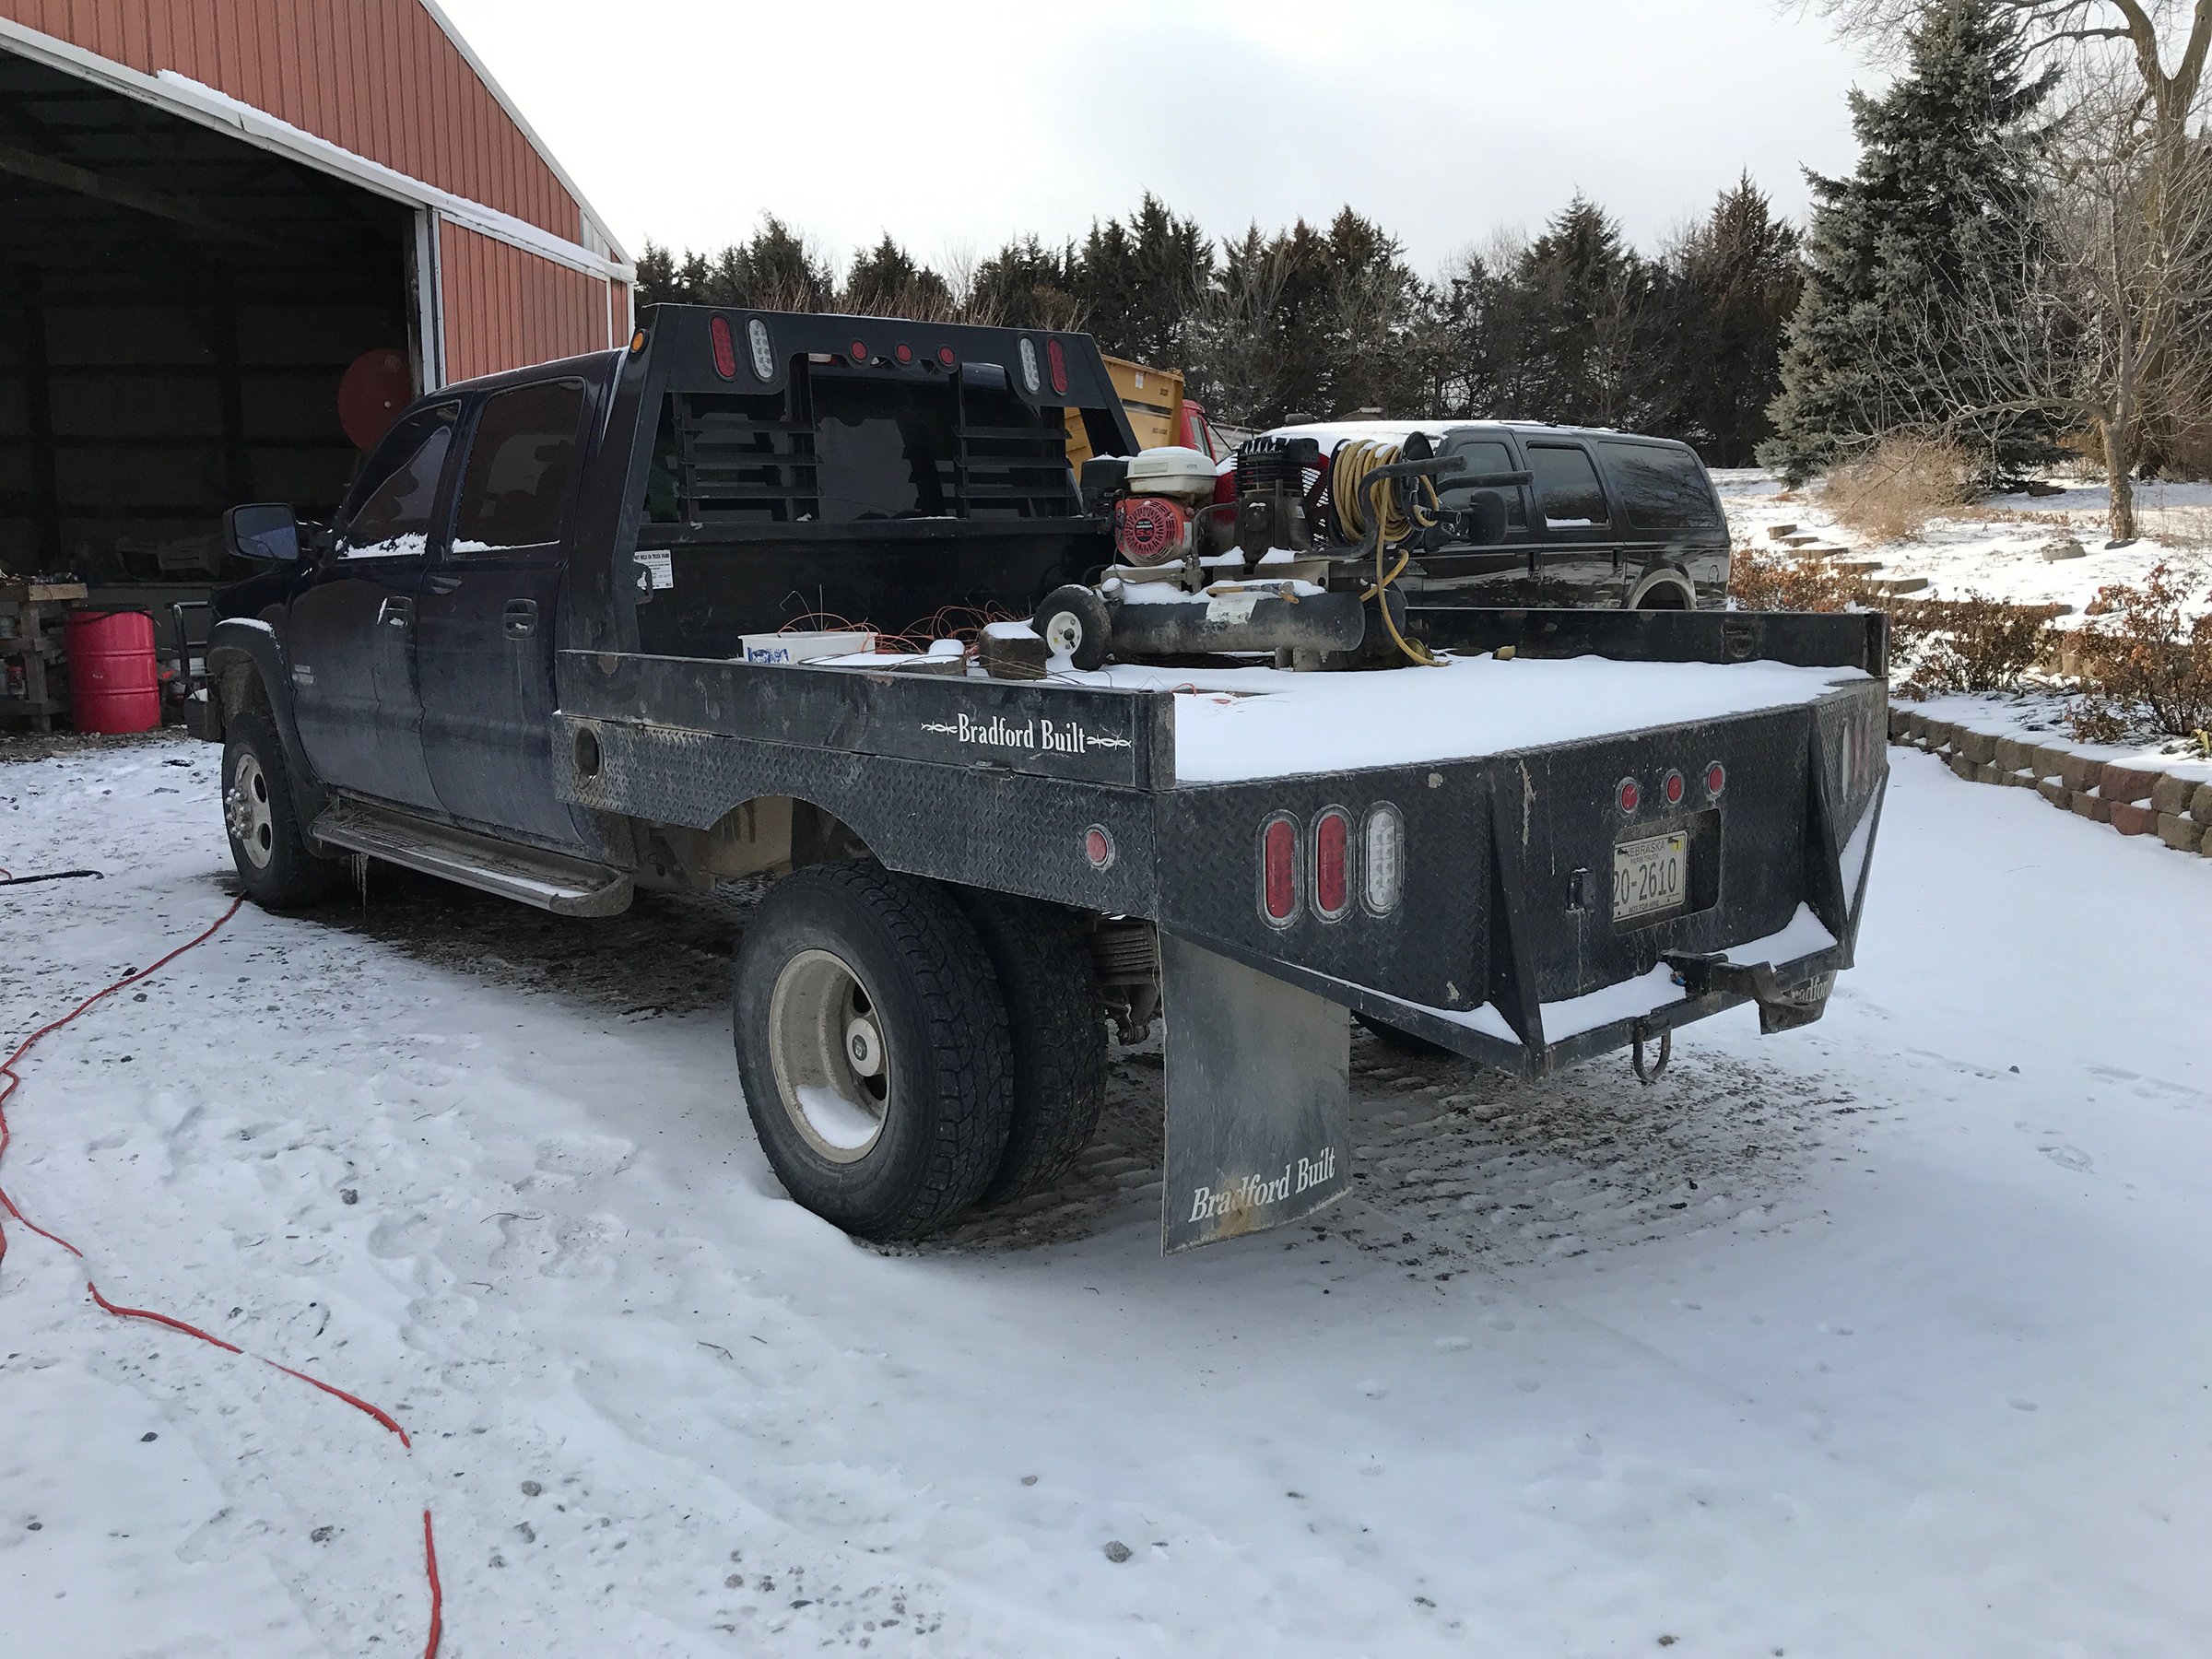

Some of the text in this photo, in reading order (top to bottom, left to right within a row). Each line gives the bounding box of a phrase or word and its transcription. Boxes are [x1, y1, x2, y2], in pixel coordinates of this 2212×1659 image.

[958, 713, 1086, 753] Bradford Built
[1624, 840, 1665, 858] NEBRASKA
[1791, 976, 1830, 1002] radfor
[1188, 1147, 1335, 1223] Bradford Built
